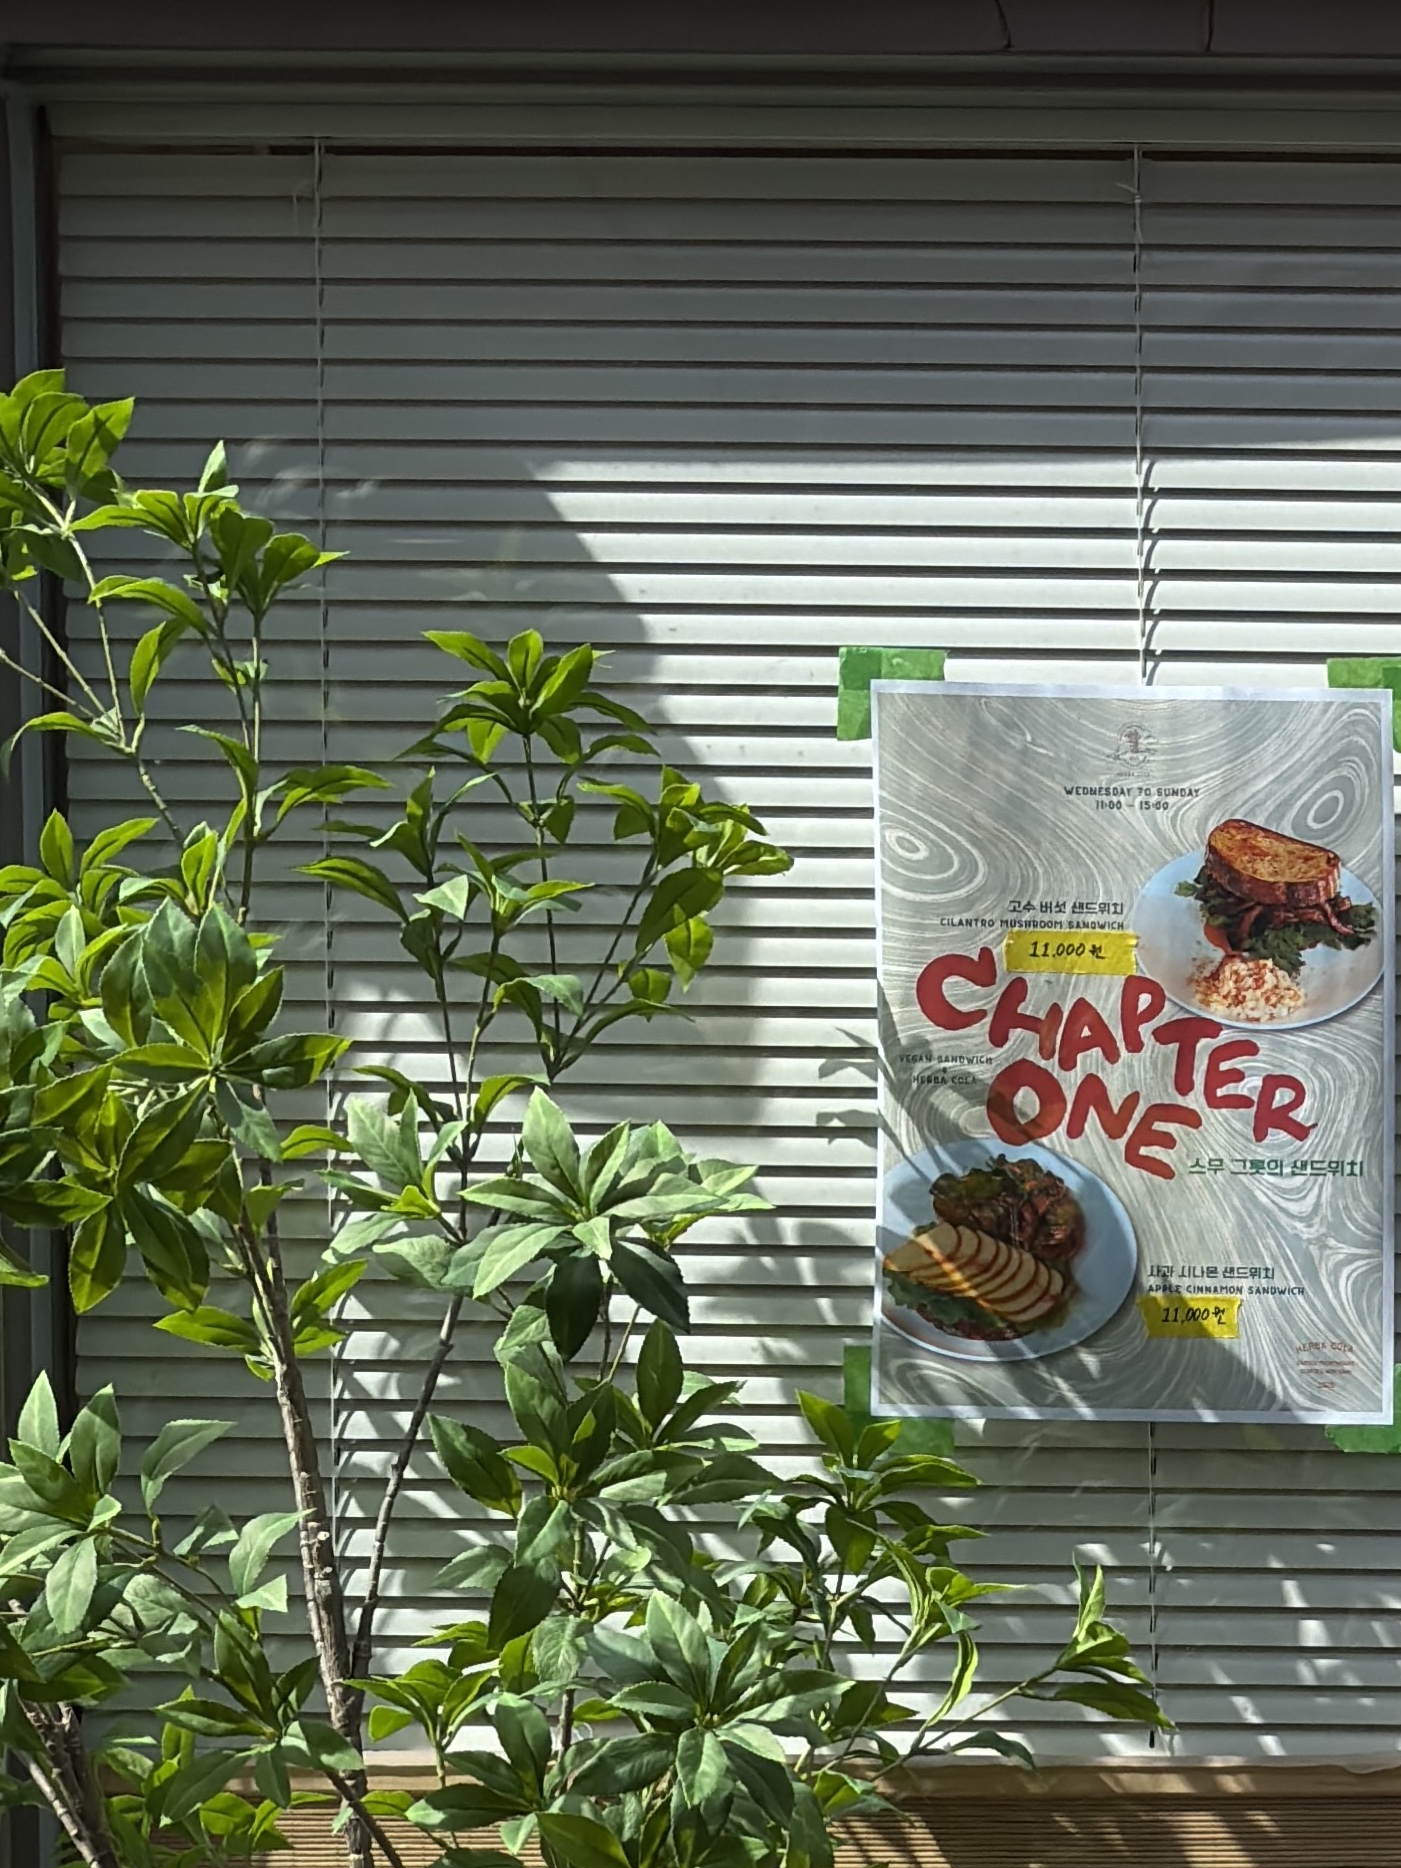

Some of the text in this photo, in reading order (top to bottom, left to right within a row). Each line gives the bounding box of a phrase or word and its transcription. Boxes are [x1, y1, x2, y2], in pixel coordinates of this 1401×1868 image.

[1064, 786, 1200, 797] WEDNESDAY TO SUNDAY
[1008, 901, 1124, 915] 고수 버섯 샌드위치
[940, 918, 1124, 930] CILANTRO MUSHROOM SANDWICH
[916, 946, 1318, 1143] CHAPTER
[899, 1054, 993, 1064] VEGAN SANDWICH
[987, 1058, 1202, 1180] ONE
[1188, 1158, 1225, 1175] 스무
[1290, 1159, 1363, 1177] 샌드위치
[1147, 1265, 1275, 1280] 사과 시나몬 샌드위치
[1147, 1284, 1305, 1296] APPLE CINNAMON SANDWICH
